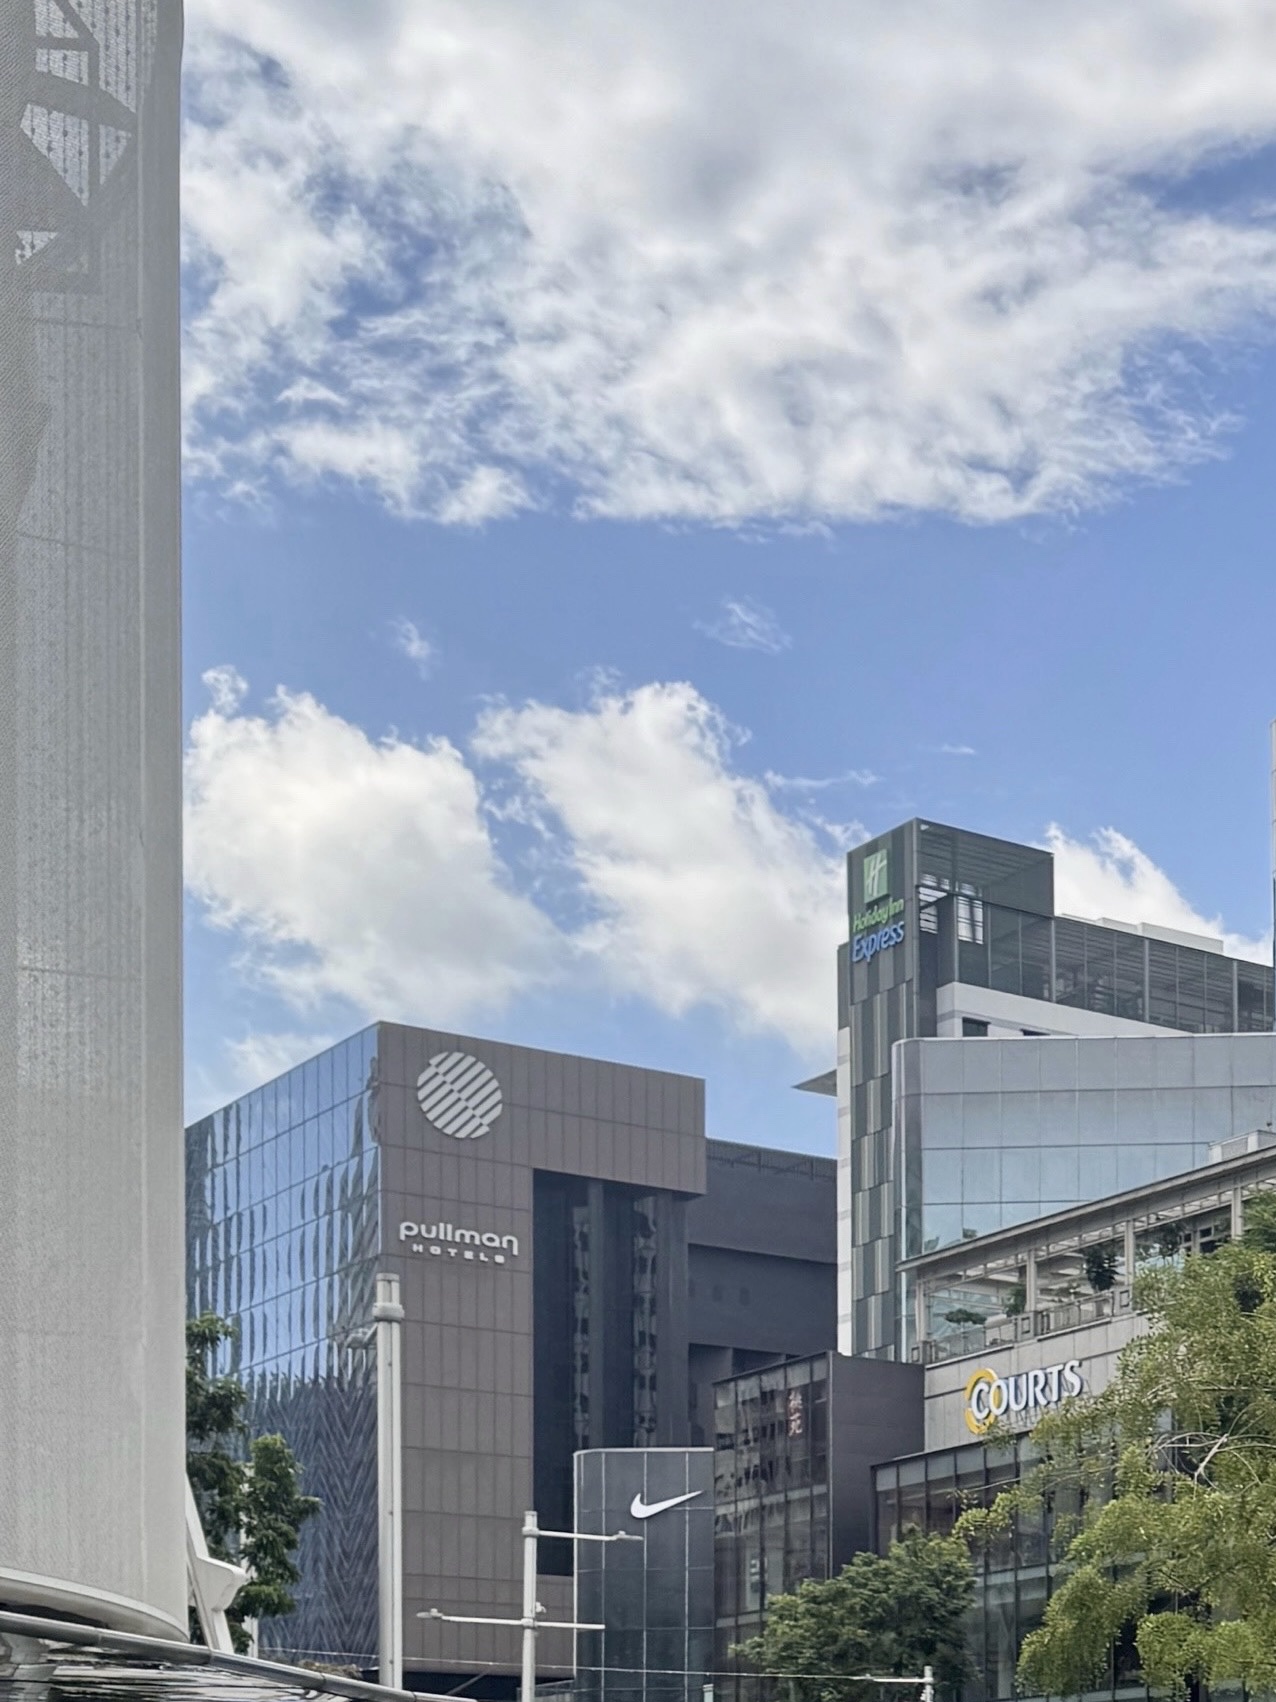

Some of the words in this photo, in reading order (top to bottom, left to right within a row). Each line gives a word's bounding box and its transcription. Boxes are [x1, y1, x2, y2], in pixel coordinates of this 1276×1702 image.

[853, 904, 889, 933] Holiday
[889, 897, 904, 916] Inn
[852, 921, 905, 963] Express
[399, 1221, 519, 1256] pullman
[412, 1243, 505, 1264] HOTELS
[971, 1360, 1082, 1420] COURTS
